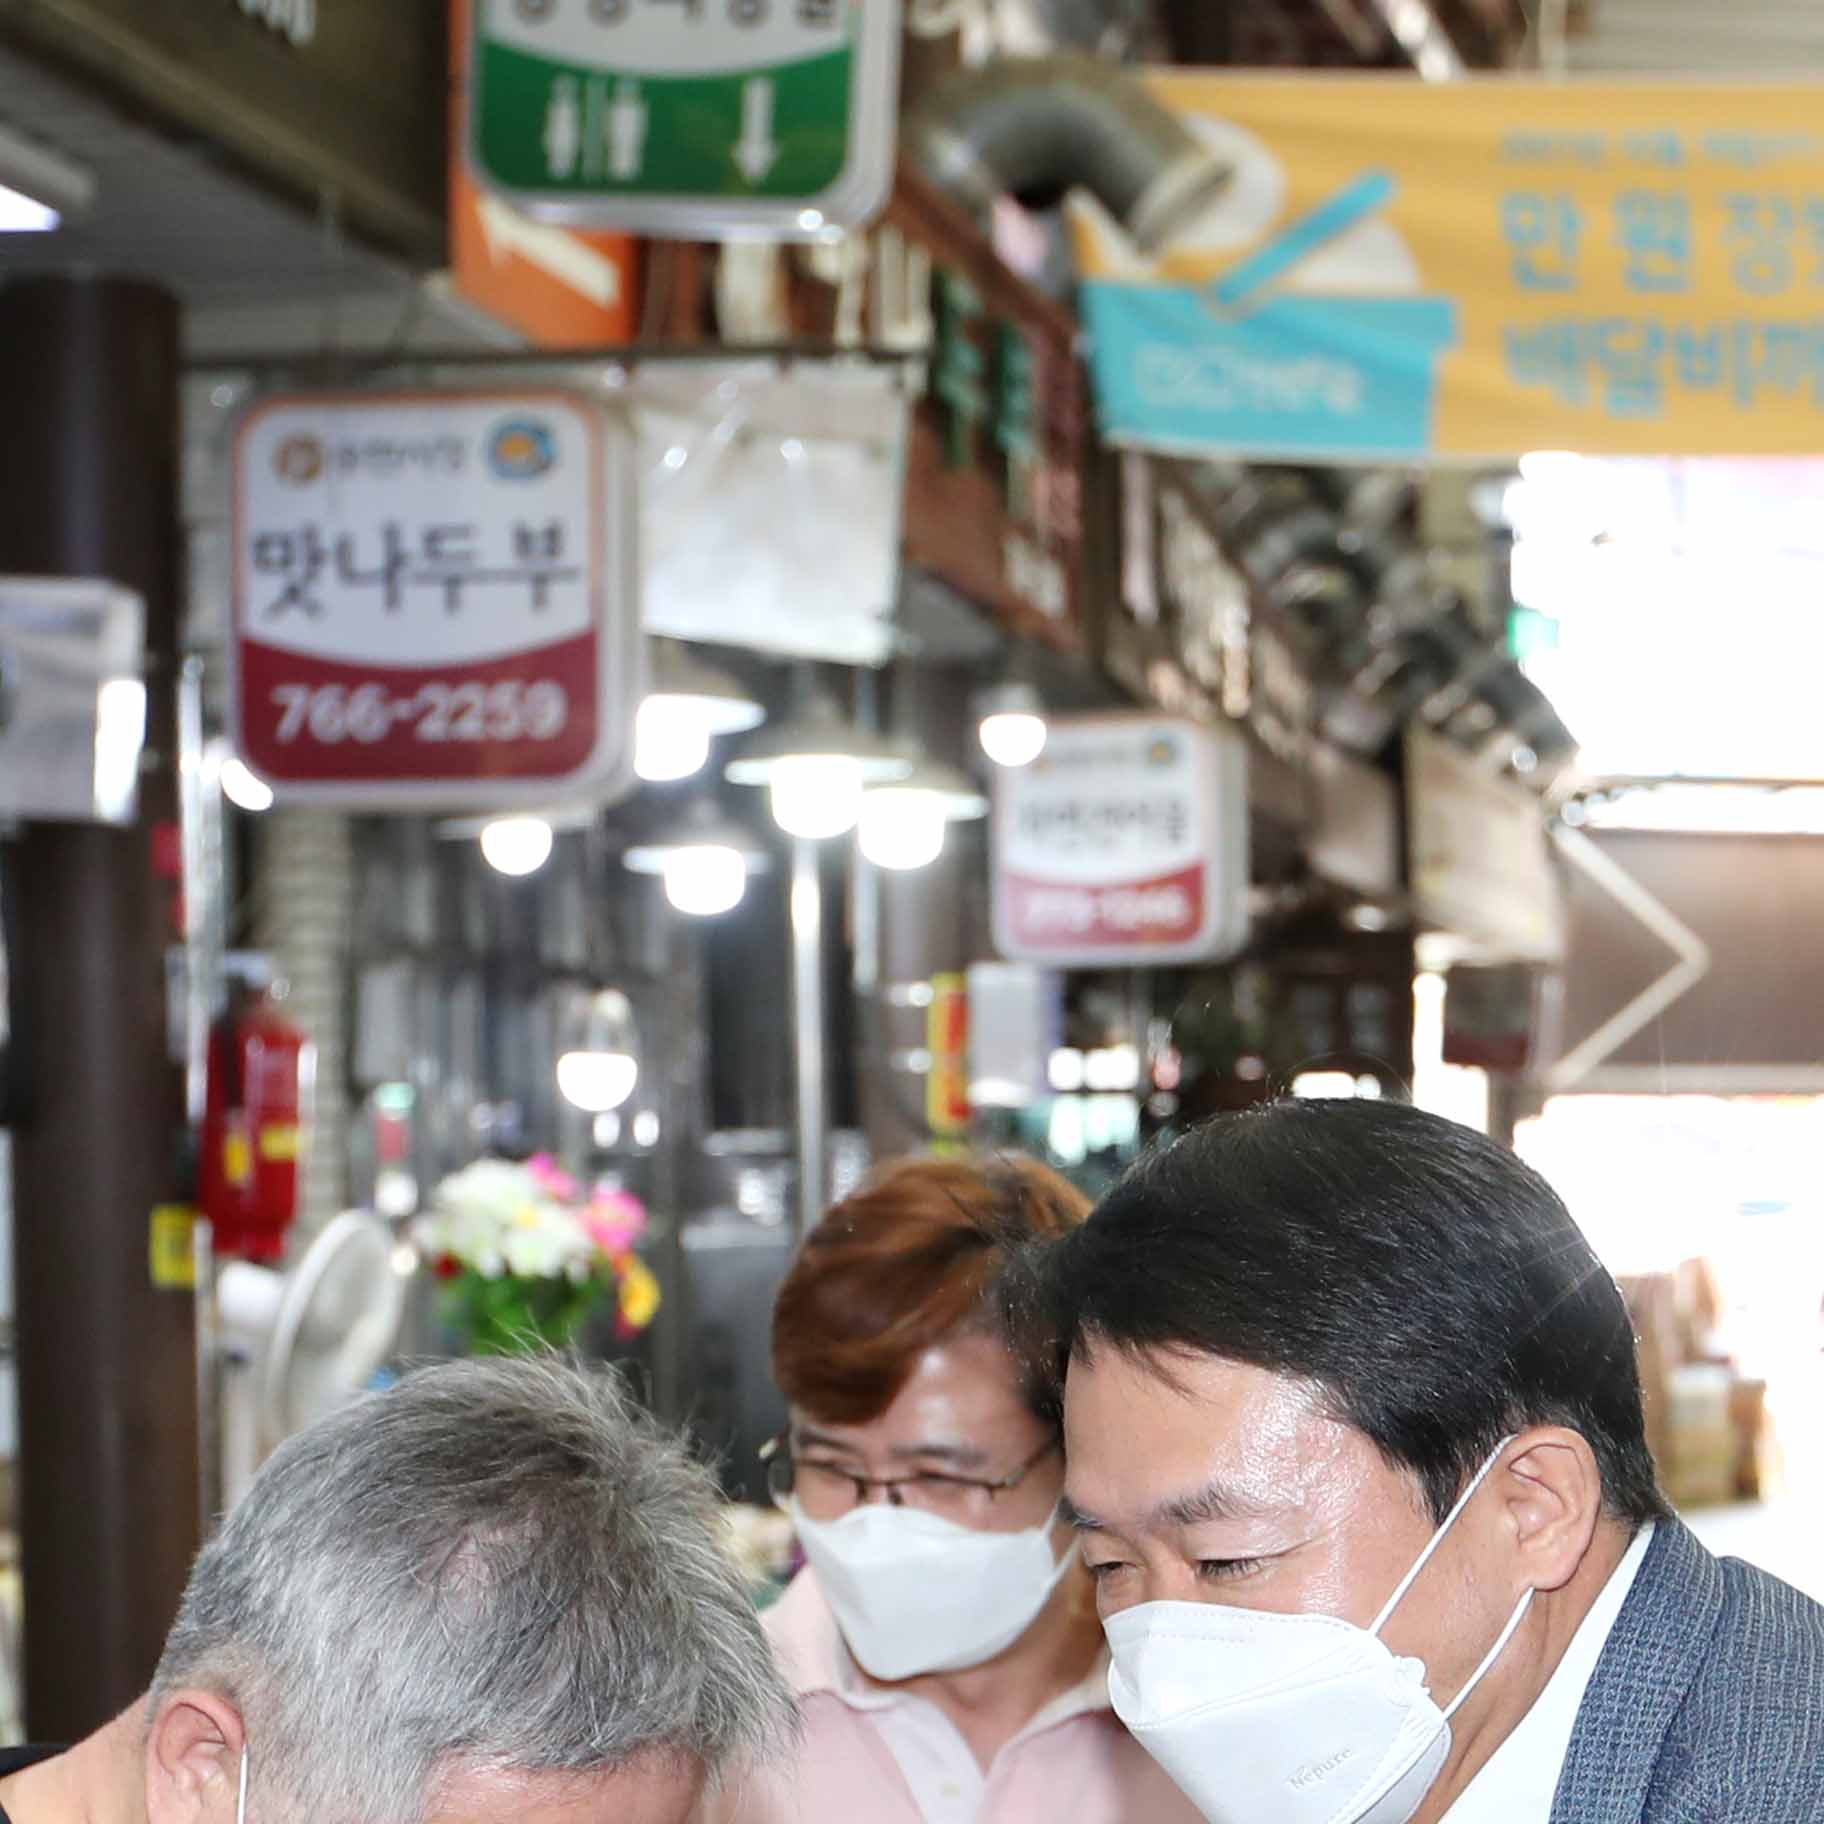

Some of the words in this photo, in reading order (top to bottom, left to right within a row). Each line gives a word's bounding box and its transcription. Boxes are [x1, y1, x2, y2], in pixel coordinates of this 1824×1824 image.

[1499, 195, 1581, 293] 만
[1613, 192, 1694, 293] 원
[270, 680, 567, 744] 766-2259
